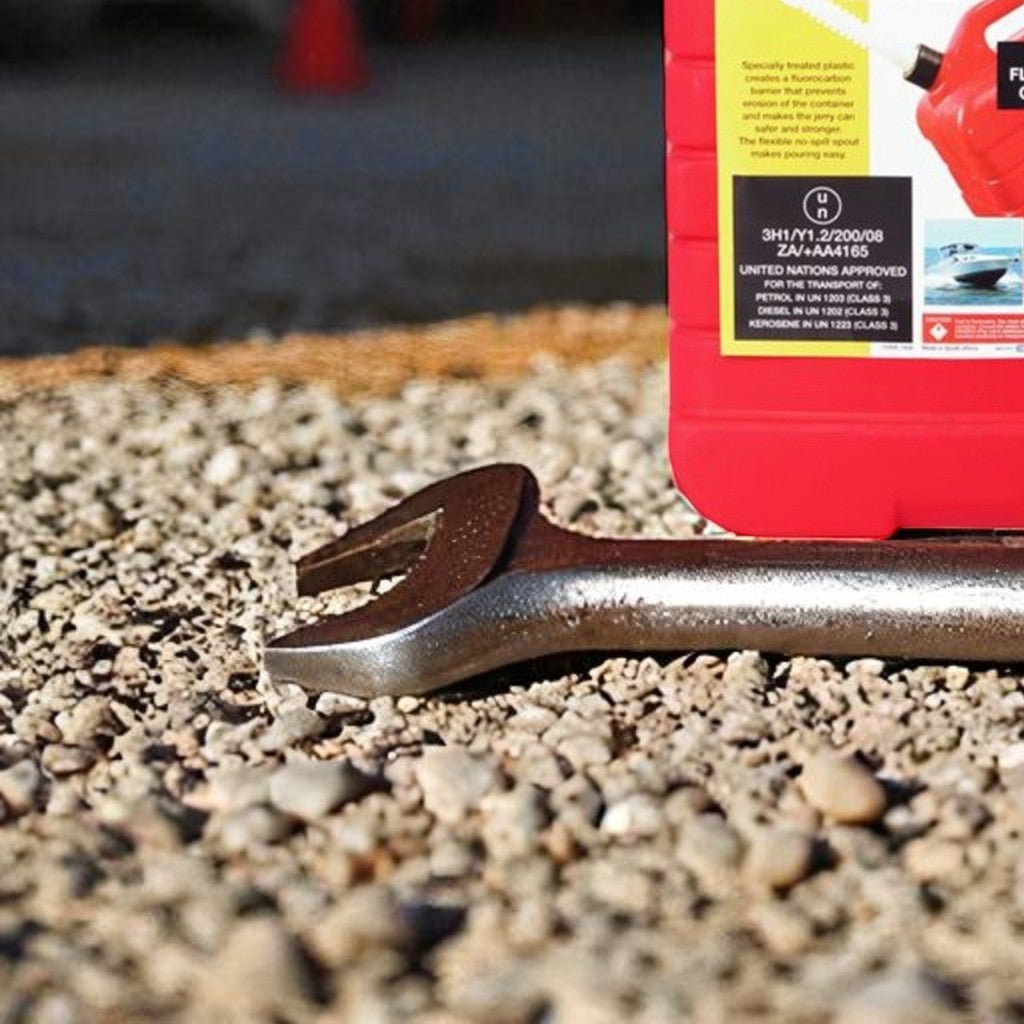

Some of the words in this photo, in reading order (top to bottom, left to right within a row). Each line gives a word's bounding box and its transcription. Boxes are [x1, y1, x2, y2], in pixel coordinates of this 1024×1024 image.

[742, 60, 784, 72] Specially
[786, 61, 821, 71] treated
[823, 61, 855, 72] plastic
[745, 74, 780, 83] creates
[784, 86, 803, 96] that
[805, 87, 846, 97] prevents
[742, 99, 778, 108] erosion
[780, 99, 790, 108] of
[792, 99, 807, 108] the
[810, 99, 854, 108] container
[742, 112, 760, 121] and
[762, 112, 794, 121] makes
[796, 112, 812, 121] the
[813, 113, 835, 123] jerry
[837, 114, 856, 122] can
[755, 125, 779, 134] safer
[781, 125, 799, 134] and
[740, 136, 756, 146] The
[758, 136, 793, 146] flexible
[832, 137, 859, 147] spout
[750, 150, 782, 158] makes
[783, 151, 821, 160] pouring
[761, 228, 884, 243] 3H1/Y1.2/200/08
[777, 244, 869, 258] ZA/+AA4165
[739, 264, 784, 276] UNITED
[786, 265, 839, 276] NATIONS
[841, 266, 908, 278] APPROVED
[764, 280, 785, 289] FOR
[786, 280, 805, 290] THE
[807, 280, 864, 290] TRANSPORT
[755, 293, 793, 303] PETROL
[795, 293, 805, 303] IN
[807, 293, 821, 303] UN
[823, 294, 845, 304] 1203
[846, 294, 881, 305] (CLASS
[757, 306, 791, 316] DIESEL
[793, 306, 803, 316] IN
[805, 307, 819, 317] UN
[844, 307, 879, 318] (CLASS
[749, 319, 800, 329] KEROSENE
[802, 320, 812, 329] IN
[814, 320, 828, 329] UN
[853, 320, 888, 331] (CLASS
